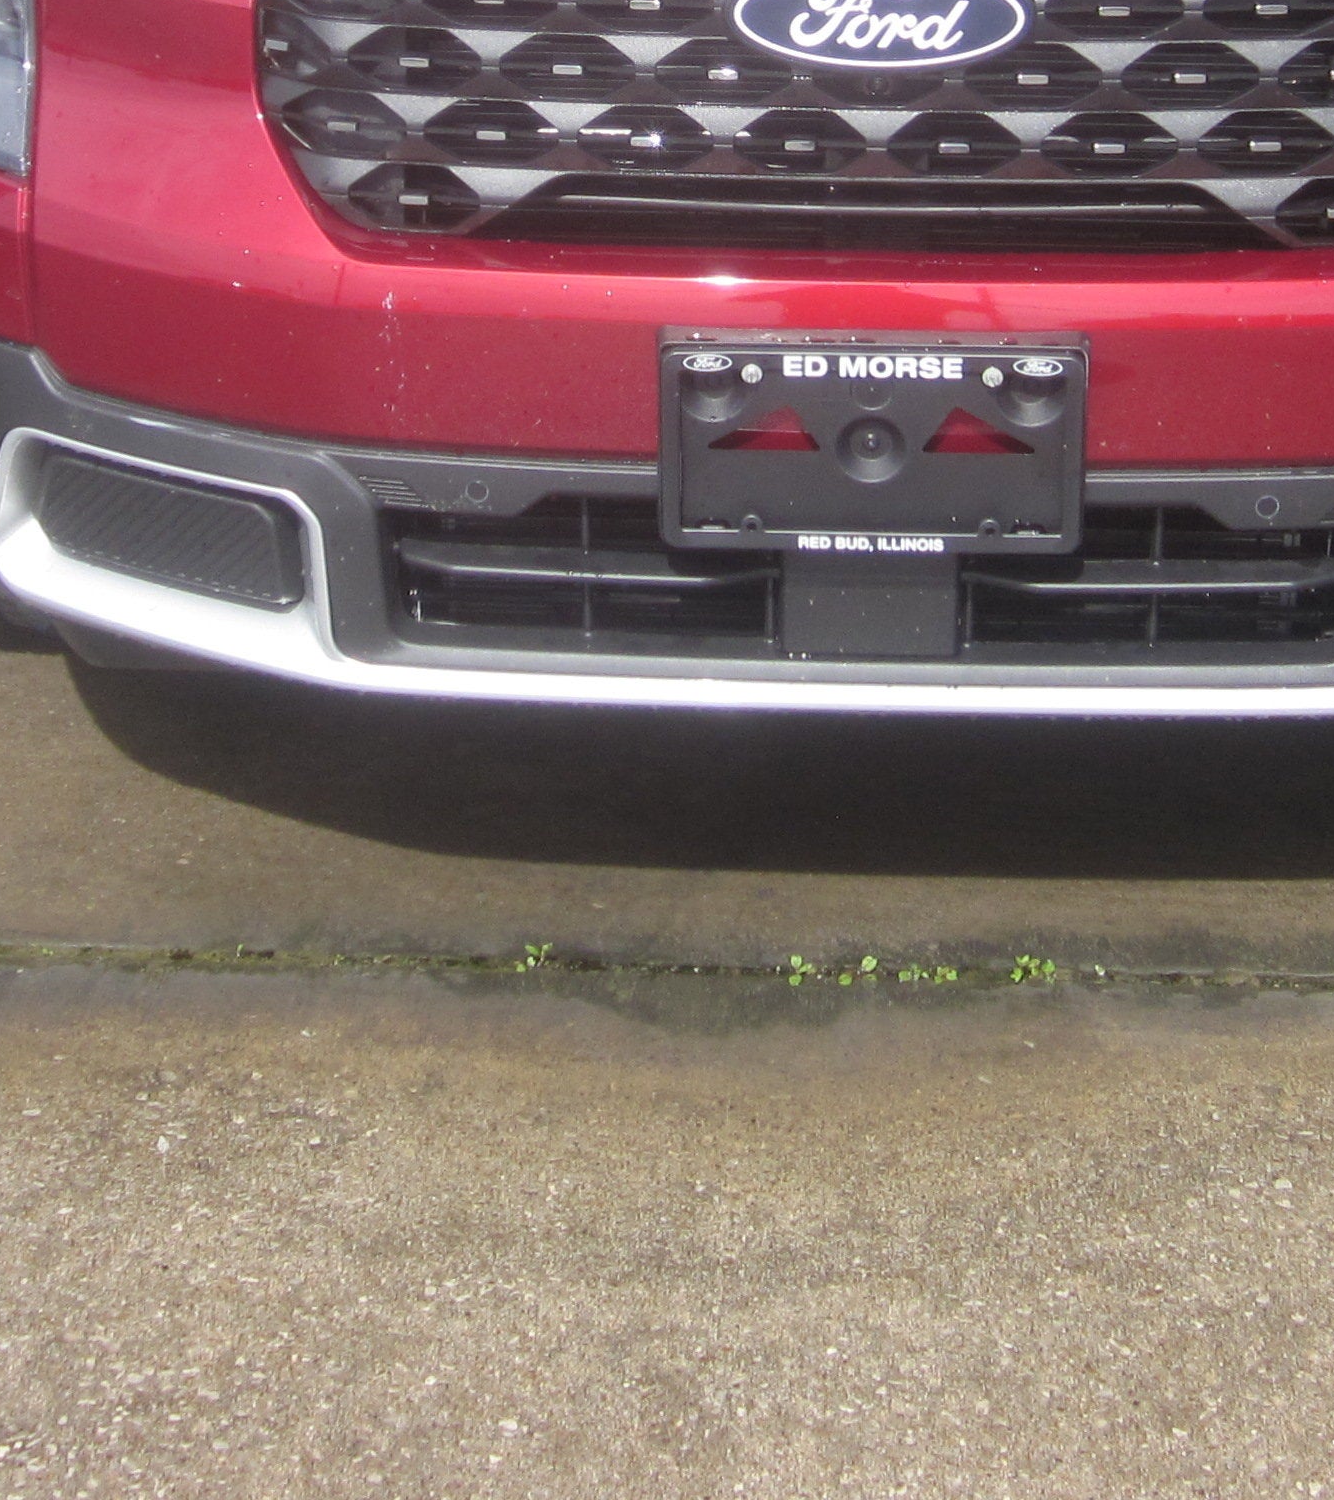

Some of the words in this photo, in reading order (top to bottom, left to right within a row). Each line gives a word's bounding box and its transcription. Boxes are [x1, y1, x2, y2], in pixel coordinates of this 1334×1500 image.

[782, 355, 829, 378] ED
[838, 356, 964, 380] MORSE
[797, 535, 831, 550] RED
[834, 536, 874, 553] BUD,
[877, 537, 945, 552] ILLINOIS
